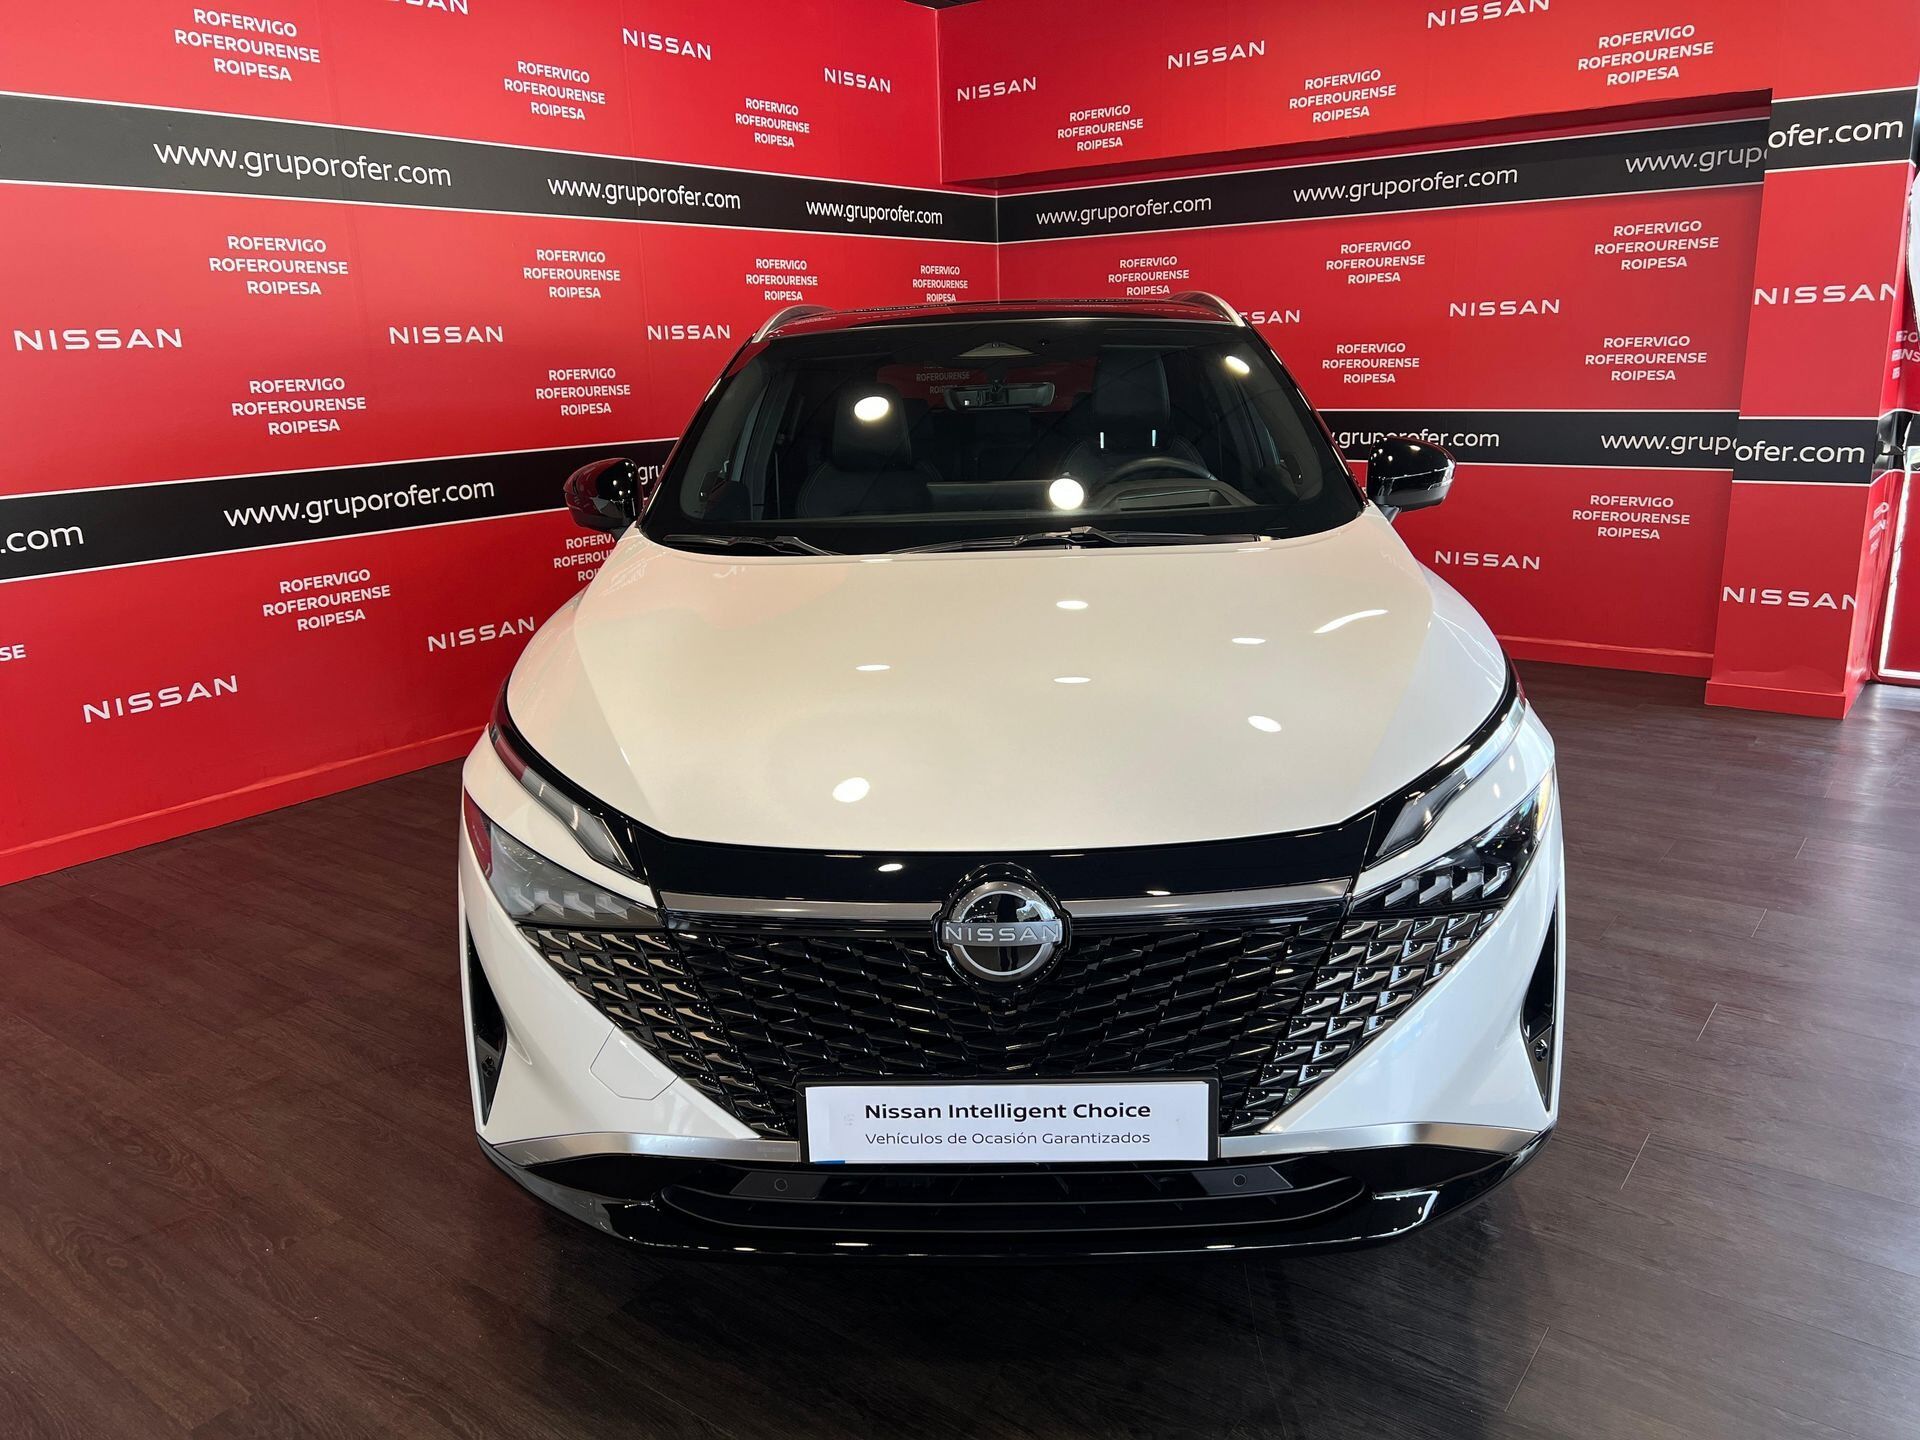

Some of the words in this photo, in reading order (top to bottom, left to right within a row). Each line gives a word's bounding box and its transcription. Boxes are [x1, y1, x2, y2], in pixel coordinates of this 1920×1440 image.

[1428, 0, 1549, 28] NISSAN
[194, 9, 297, 37] ROFERVIGO
[623, 28, 711, 60] NISSAN
[1599, 25, 1695, 49] ROFERVIGO
[175, 29, 320, 63] ROFEROURENSE
[1168, 40, 1264, 69] NISSAN
[1578, 42, 1714, 70] ROFEROURENSE
[214, 58, 292, 81] ROIPESA
[518, 61, 590, 83] ROFERVIGO
[1607, 66, 1679, 86] ROIPESA
[824, 68, 890, 93] NISSAN
[1305, 69, 1381, 90] ROFERVIGO
[504, 78, 605, 104] ROFEROURENSE
[957, 77, 1036, 101] NISSAN
[1290, 85, 1396, 109] ROFEROURENSE
[531, 102, 585, 120] ROIPESA
[746, 98, 799, 116] ROFERVIGO
[1070, 105, 1130, 122] ROFERVIGO
[1313, 106, 1370, 123] ROIPESA
[735, 113, 810, 133] ROFEROURENSE
[1058, 118, 1143, 138] ROFEROURENSE
[754, 132, 795, 147] ROIPESA
[1768, 121, 1903, 148] ofer.com
[1077, 137, 1123, 151] ROIPESA
[153, 144, 451, 186] www.gruporofer.com
[547, 179, 740, 209] www.gruporofer.com
[1293, 169, 1517, 202] www.gruporofer.com
[806, 201, 942, 224] www.gruporofer.com
[1036, 198, 1211, 225] www.gruporofer.com
[1614, 221, 1702, 236] ROFERVIGO
[227, 236, 326, 253] ROFERVIGO
[1341, 240, 1411, 254] ROFERVIGO
[1595, 237, 1719, 255] ROFEROURENSE
[536, 249, 606, 263] ROFERVIGO
[756, 258, 807, 270] ROFERVIGO
[1120, 256, 1177, 268] ROFERVIGO
[1326, 255, 1425, 270] ROFEROURENSE
[1621, 256, 1687, 270] ROIPESA
[209, 258, 348, 274] ROFEROURENSE
[523, 267, 621, 281] ROFEROURENSE
[921, 265, 960, 275] ROFERVIGO
[746, 274, 818, 286] ROFEROURENSE
[913, 279, 968, 289] ROFEROURENSE
[1108, 270, 1189, 283] ROFEROURENSE
[1348, 272, 1401, 284] ROIPESA
[247, 281, 322, 295] ROIPESA
[549, 286, 601, 298] ROIPESA
[765, 291, 803, 301] ROIPESA
[1127, 285, 1170, 296] ROIPESA
[926, 292, 957, 302] ROIPESA
[1450, 299, 1559, 317] NISSAN
[14, 329, 182, 351] NISSAN
[389, 326, 503, 344] NISSAN
[647, 325, 730, 340] NISSAN
[1337, 343, 1406, 354] ROFERVIGO
[1604, 336, 1690, 348] ROFERVIGO
[1322, 358, 1420, 369] ROFEROURENSE
[1585, 353, 1707, 365] ROFEROURENSE
[549, 368, 616, 381] ROFERVIGO
[1344, 373, 1395, 383] ROIPESA
[1611, 370, 1676, 381] ROIPESA
[249, 378, 345, 393] ROFERVIGO
[536, 385, 630, 399] ROFEROURENSE
[232, 397, 366, 416] ROFEROURENSE
[561, 403, 612, 416] ROIPESA
[268, 419, 341, 435] ROIPESA
[1732, 438, 1865, 463] ofer.com
[223, 482, 494, 526] www.gruporofer.com
[1590, 495, 1673, 507] ROFERVIGO
[1573, 510, 1690, 524] ROFEROURENSE
[1598, 527, 1660, 539] ROIPESA
[565, 534, 617, 550] ROFERV
[1435, 551, 1540, 570] NISSAN
[280, 569, 370, 594] ROFERVIGO
[263, 585, 391, 617] ROFEROURENSE
[297, 609, 366, 631] ROIPESA
[428, 616, 534, 652] NISSAN
[83, 675, 238, 723] NISSAN
[945, 924, 1060, 942] NISSAN
[865, 1104, 944, 1119] Nissan
[949, 1103, 1067, 1122] Intelligent
[1073, 1103, 1151, 1118] Choice
[865, 1131, 942, 1144] Vehículos
[948, 1131, 967, 1144] de
[972, 1131, 1037, 1144] Ocasión
[1042, 1131, 1151, 1145] Garantizados
